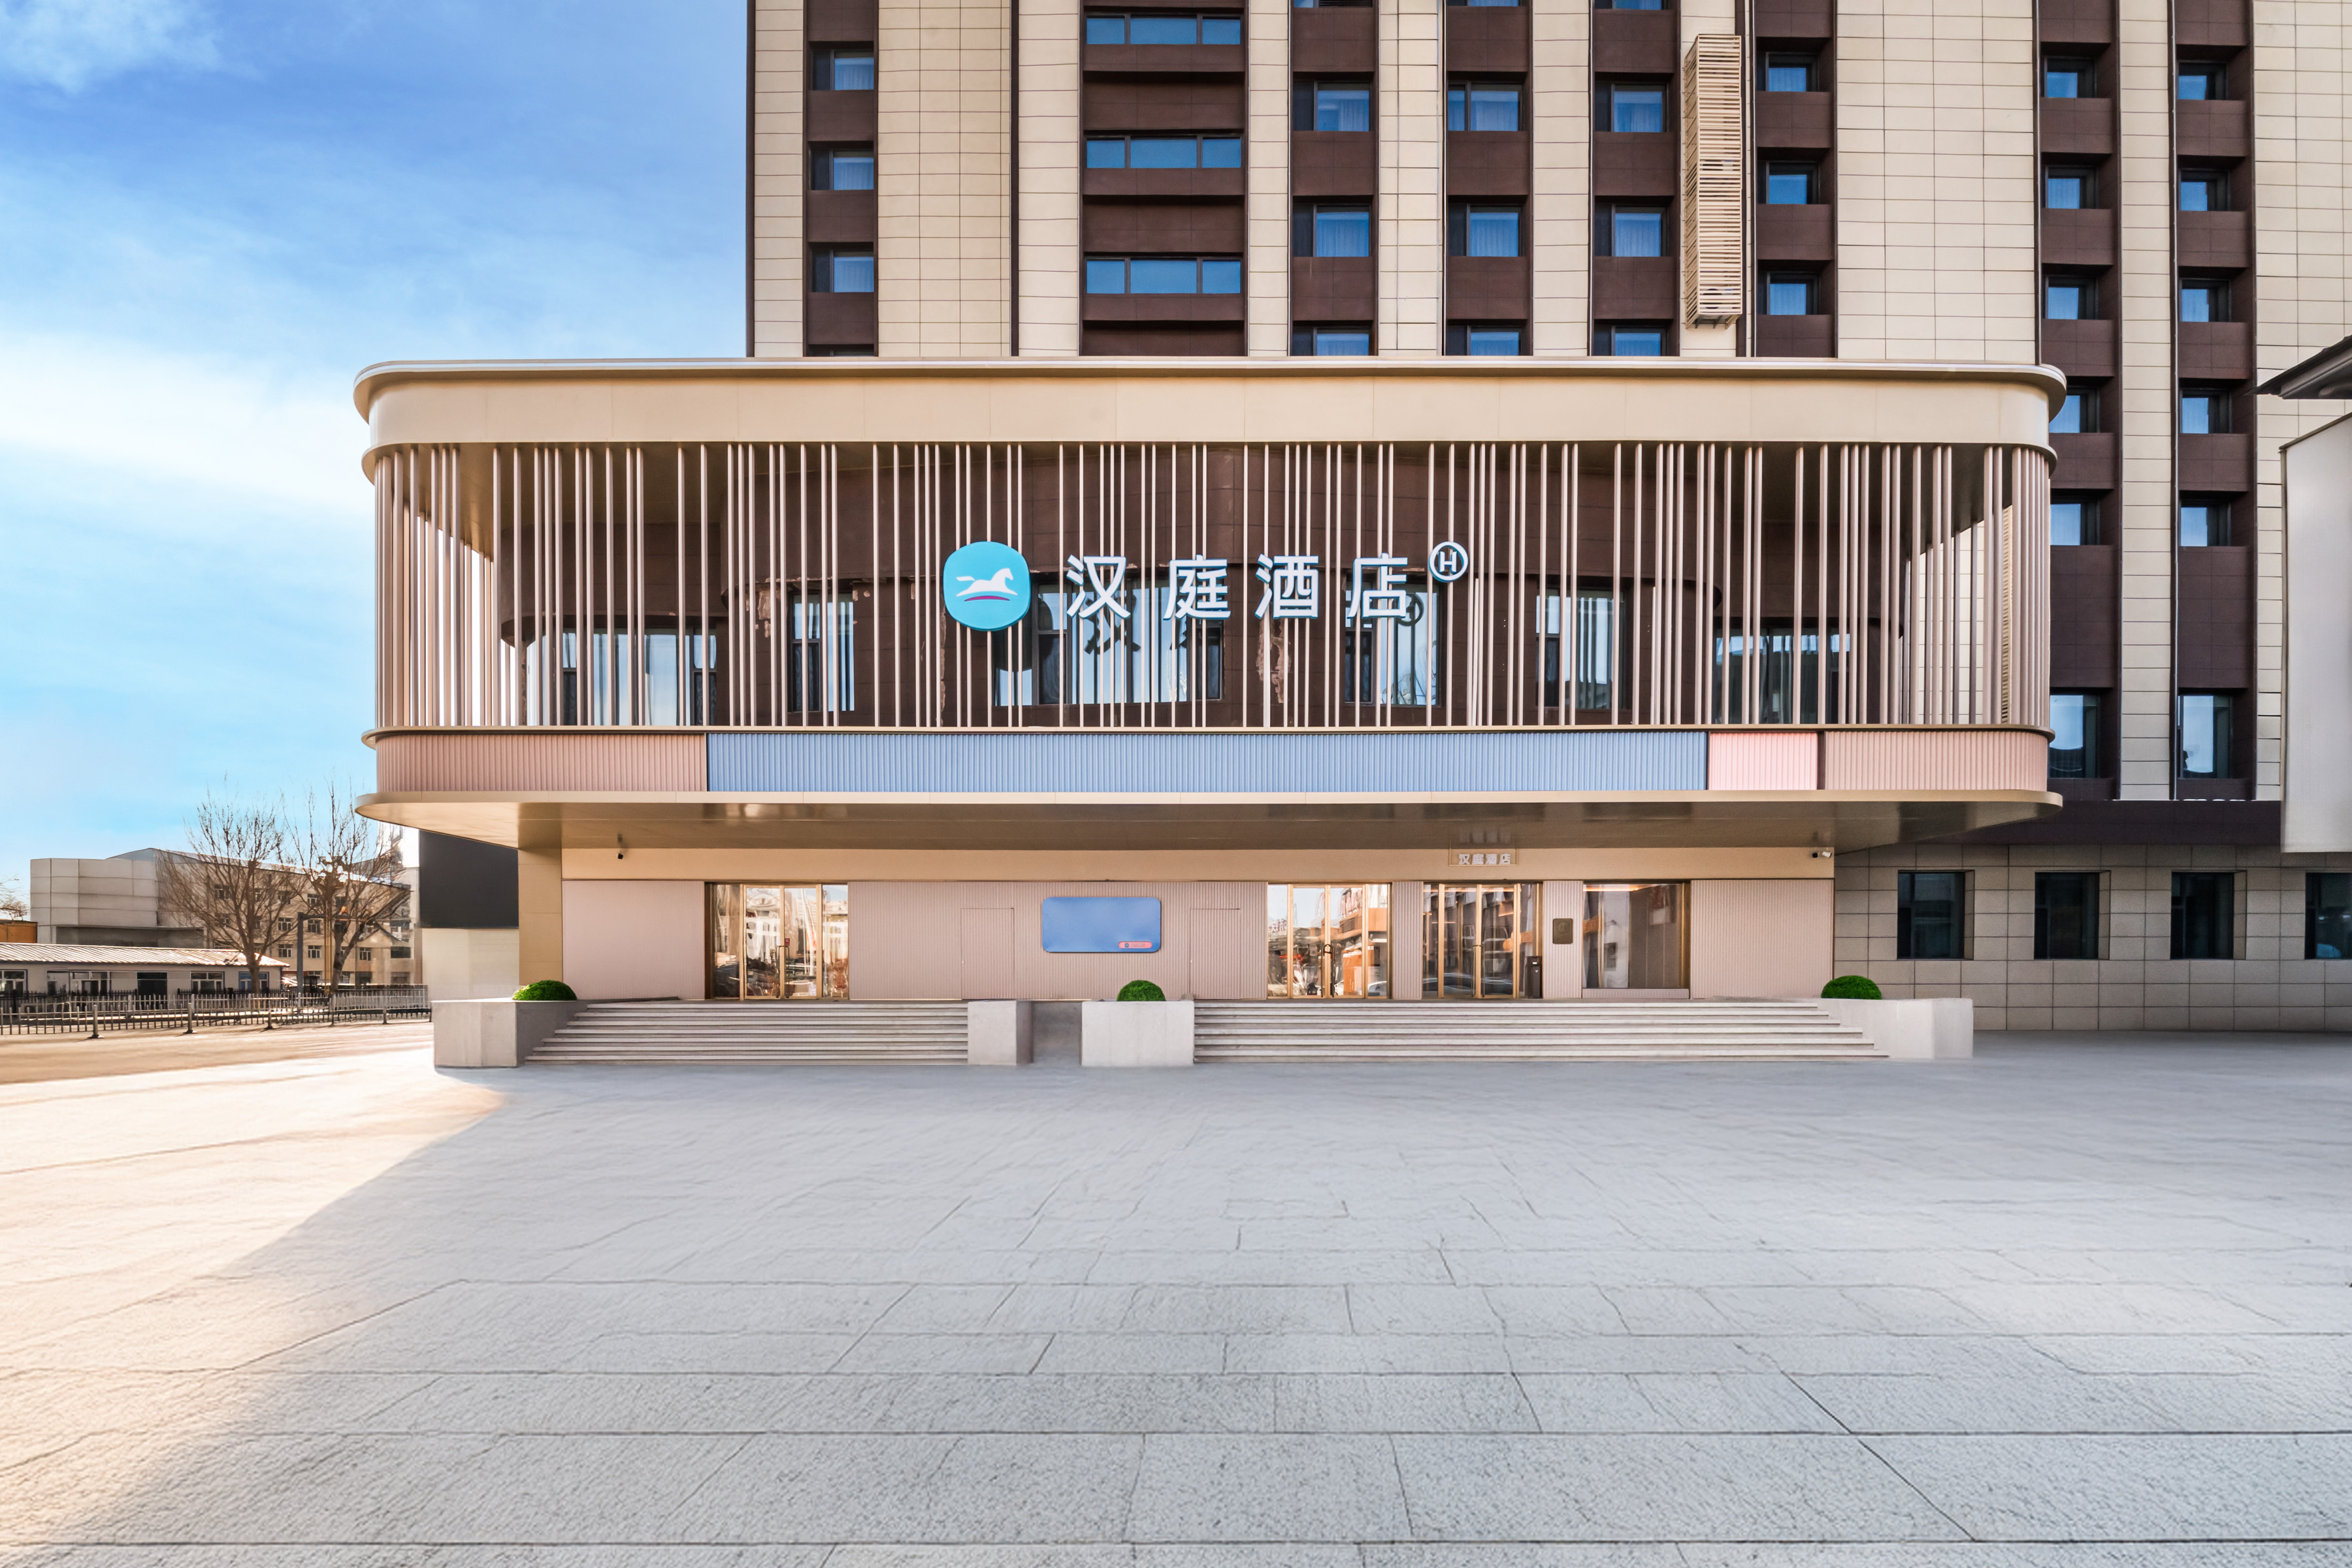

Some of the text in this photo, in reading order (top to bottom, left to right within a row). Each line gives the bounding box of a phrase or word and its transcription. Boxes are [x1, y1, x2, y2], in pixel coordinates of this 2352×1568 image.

[1066, 553, 1409, 620] 汉庭酒店
[1458, 853, 1511, 865] 汉庭酒店
